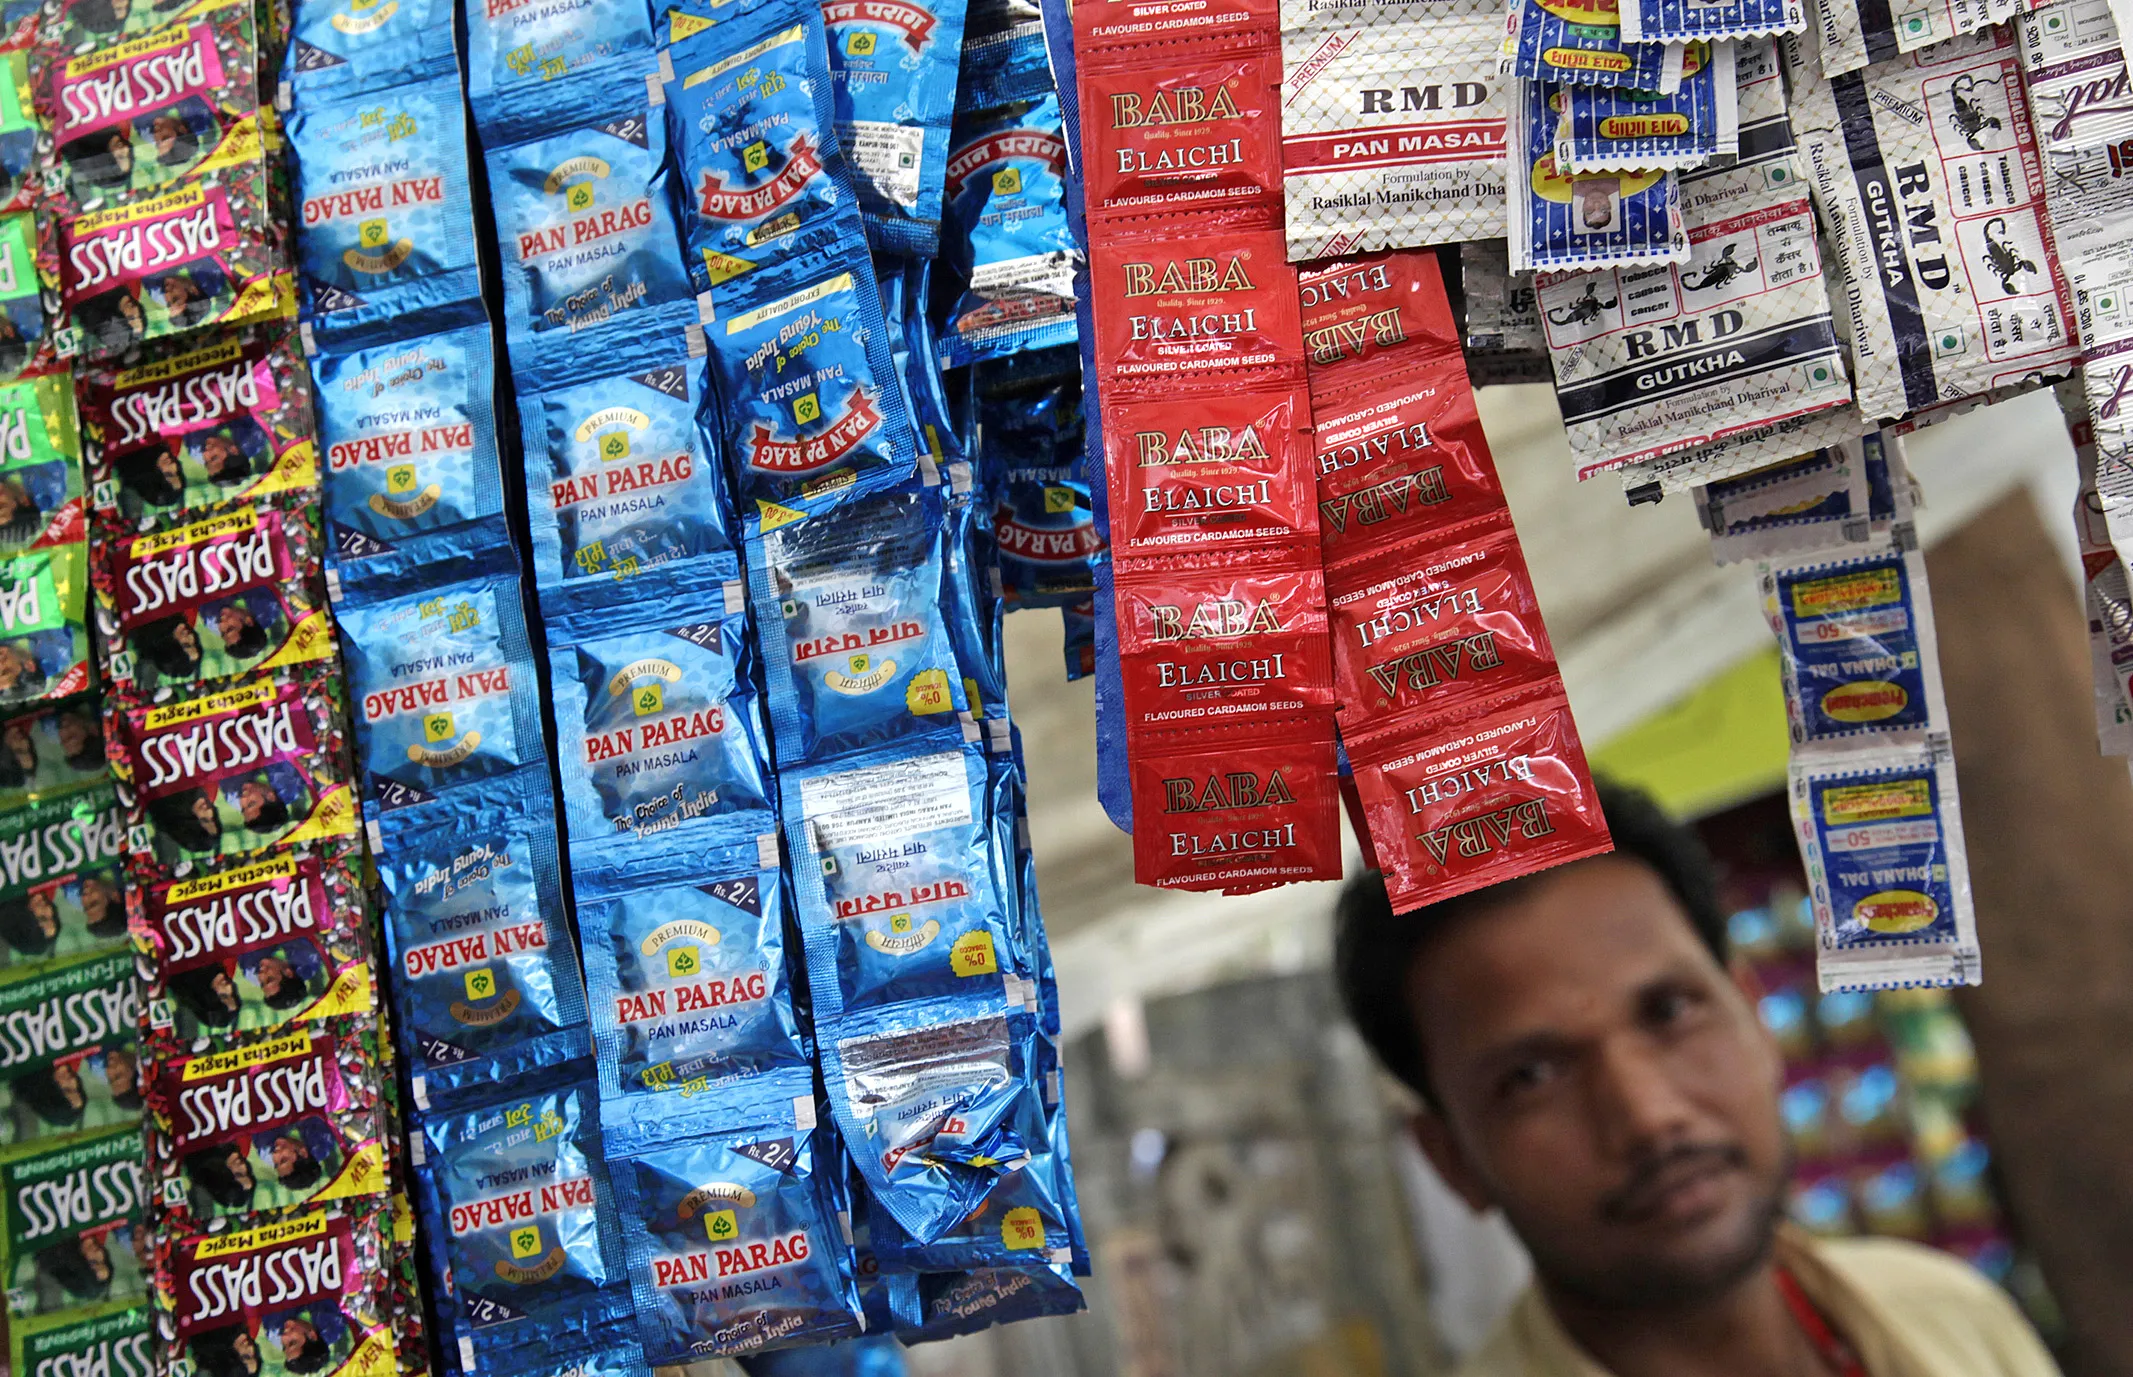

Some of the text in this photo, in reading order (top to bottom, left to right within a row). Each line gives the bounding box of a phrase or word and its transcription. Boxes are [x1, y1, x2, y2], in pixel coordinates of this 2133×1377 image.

[1092, 11, 1249, 36] FLAVOURED CARDAMOM SEEDS
[73, 27, 184, 71] Meetha Magic
[1291, 35, 1345, 89] PREMIUM
[61, 40, 206, 129] PASS PASS
[1109, 84, 1244, 130] BABA
[1874, 91, 1925, 124] PREMIUM
[1333, 139, 1389, 159] PAN
[2003, 64, 2044, 197] TOBACCO KILLS
[1115, 138, 1244, 174] ELAICHI
[1382, 168, 1470, 185] Formulation by
[1313, 192, 1371, 210] Rasiklal
[1375, 184, 1470, 205] Manikchand
[1958, 166, 1972, 209] cancer
[1979, 161, 1993, 205] causes
[1998, 154, 2015, 205] Tobacco
[70, 201, 220, 291] PASS PASS
[520, 200, 652, 259] PAN PARAG
[1810, 143, 1874, 357] Rasiklal Manikchand Dhariwal
[1847, 198, 1872, 280] Formulation by
[1866, 181, 1905, 288] GUTKHA
[1121, 256, 1256, 298] BABA
[1622, 265, 1668, 285] Tobacco
[1628, 283, 1668, 300] causes
[756, 288, 820, 321] EXPORT QUALITY
[1128, 309, 1258, 341] ELAICHI
[1630, 300, 1670, 316] cancer
[745, 309, 822, 371] Young India
[777, 318, 842, 374] The Choice of
[760, 363, 843, 404] PAN MASALA
[1117, 353, 1275, 374] FLAVOURED CARDAMOM SEEDS
[1636, 351, 1745, 391] GUTKHA
[357, 406, 440, 427] PAN MASALA
[1619, 383, 1790, 438] Rasiklal Manikchand Dhariwal
[1665, 385, 1731, 409] Formulation by
[330, 423, 473, 469] PAN PARAG
[760, 409, 871, 466] PAN PARAG
[1135, 424, 1271, 468] BABA
[552, 454, 692, 508] PAN PARAG
[1142, 479, 1271, 513] ELAICHI
[1318, 465, 1453, 533] BABA
[47, 502, 81, 540] NEW
[580, 495, 665, 522] PAN MASALA
[126, 530, 275, 614] PASS PASS
[1150, 598, 1282, 643] BABA
[1355, 587, 1485, 648] ELAICHI
[1156, 653, 1287, 688] ELAICHI
[1366, 631, 1505, 699] BABA
[154, 685, 270, 725] Meetha Magic
[366, 667, 510, 718] PAN PARAG
[1144, 700, 1304, 722] FLAVOURED CARDAMOM SEEDS
[141, 701, 297, 788] PASS PASS
[586, 707, 724, 763] PAN PARAG
[1382, 716, 1536, 773] FLAVOURED CARDAMOM SEEDS
[1425, 745, 1499, 774] SILVER COATED
[1162, 769, 1297, 814] BABA
[1404, 754, 1535, 815] ELAICHI
[613, 785, 684, 832] The Choice of
[633, 790, 719, 840] Young India
[47, 808, 120, 875] PASS
[1168, 823, 1297, 856] ELAICHI
[1416, 797, 1557, 866] BABA
[1847, 831, 1871, 850] 50
[1838, 864, 1926, 887] DHANA DAL
[163, 878, 314, 962] PASS PASS
[652, 924, 709, 947] PREMIUM
[407, 923, 545, 975] PAN PARAG
[959, 943, 987, 953] TOBACCO
[965, 952, 985, 967] 0%
[617, 973, 767, 1025] PAN PARAG
[648, 1013, 738, 1041] PAN MASALA
[191, 1037, 304, 1074] Meetha Magic
[179, 1056, 328, 1140] PASS PASS
[350, 1155, 375, 1188] NEW
[477, 1161, 557, 1188] PAN MASALA
[18, 1180, 92, 1240] PASS
[452, 1177, 594, 1233] PAN PARAG
[189, 1236, 341, 1320] PASS PASS
[654, 1233, 809, 1287] PAN PARAG
